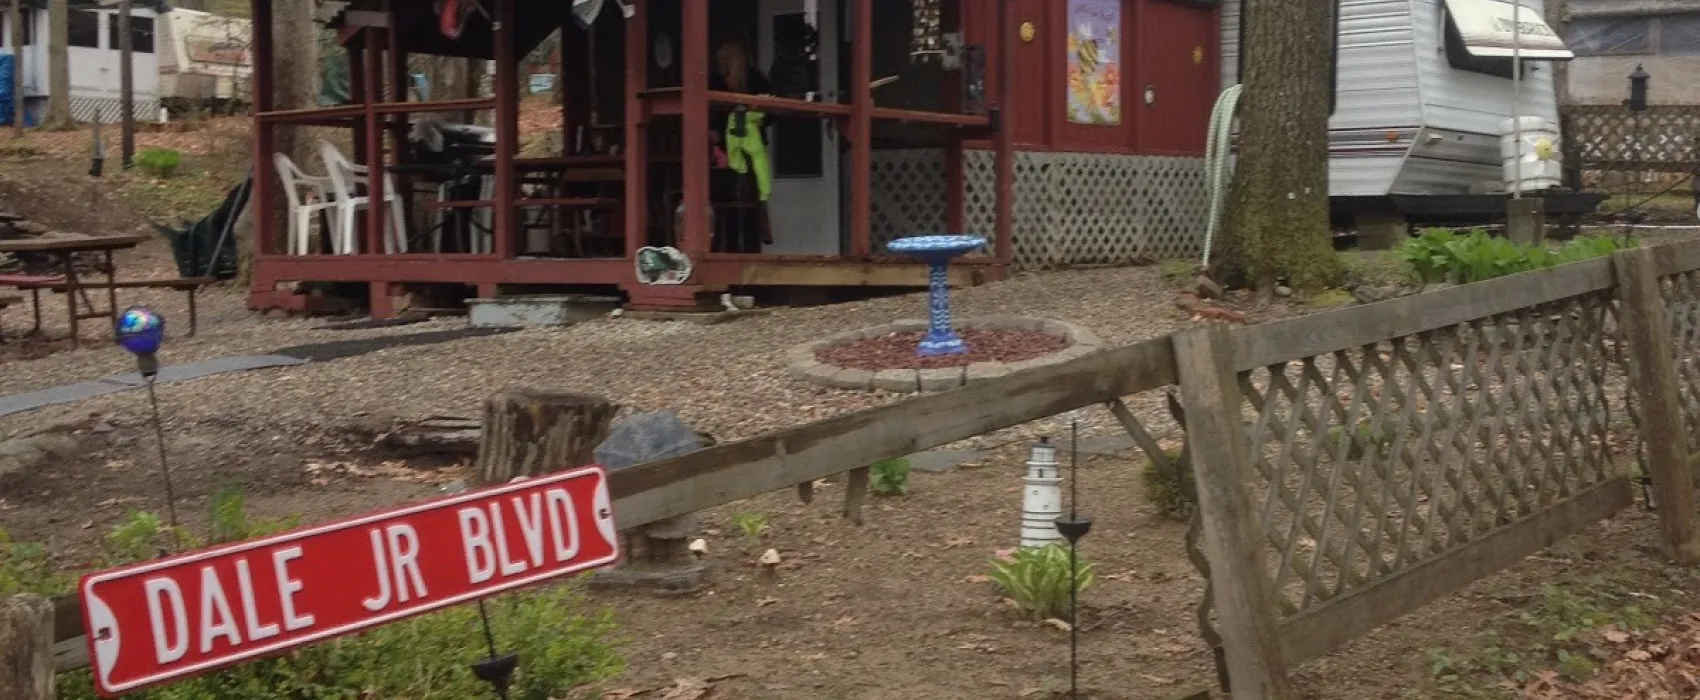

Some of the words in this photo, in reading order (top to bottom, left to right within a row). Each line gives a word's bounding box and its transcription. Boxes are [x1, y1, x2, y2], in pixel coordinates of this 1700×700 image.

[145, 547, 315, 663] DALE
[362, 524, 427, 611] JR
[458, 488, 580, 584] BLVD
